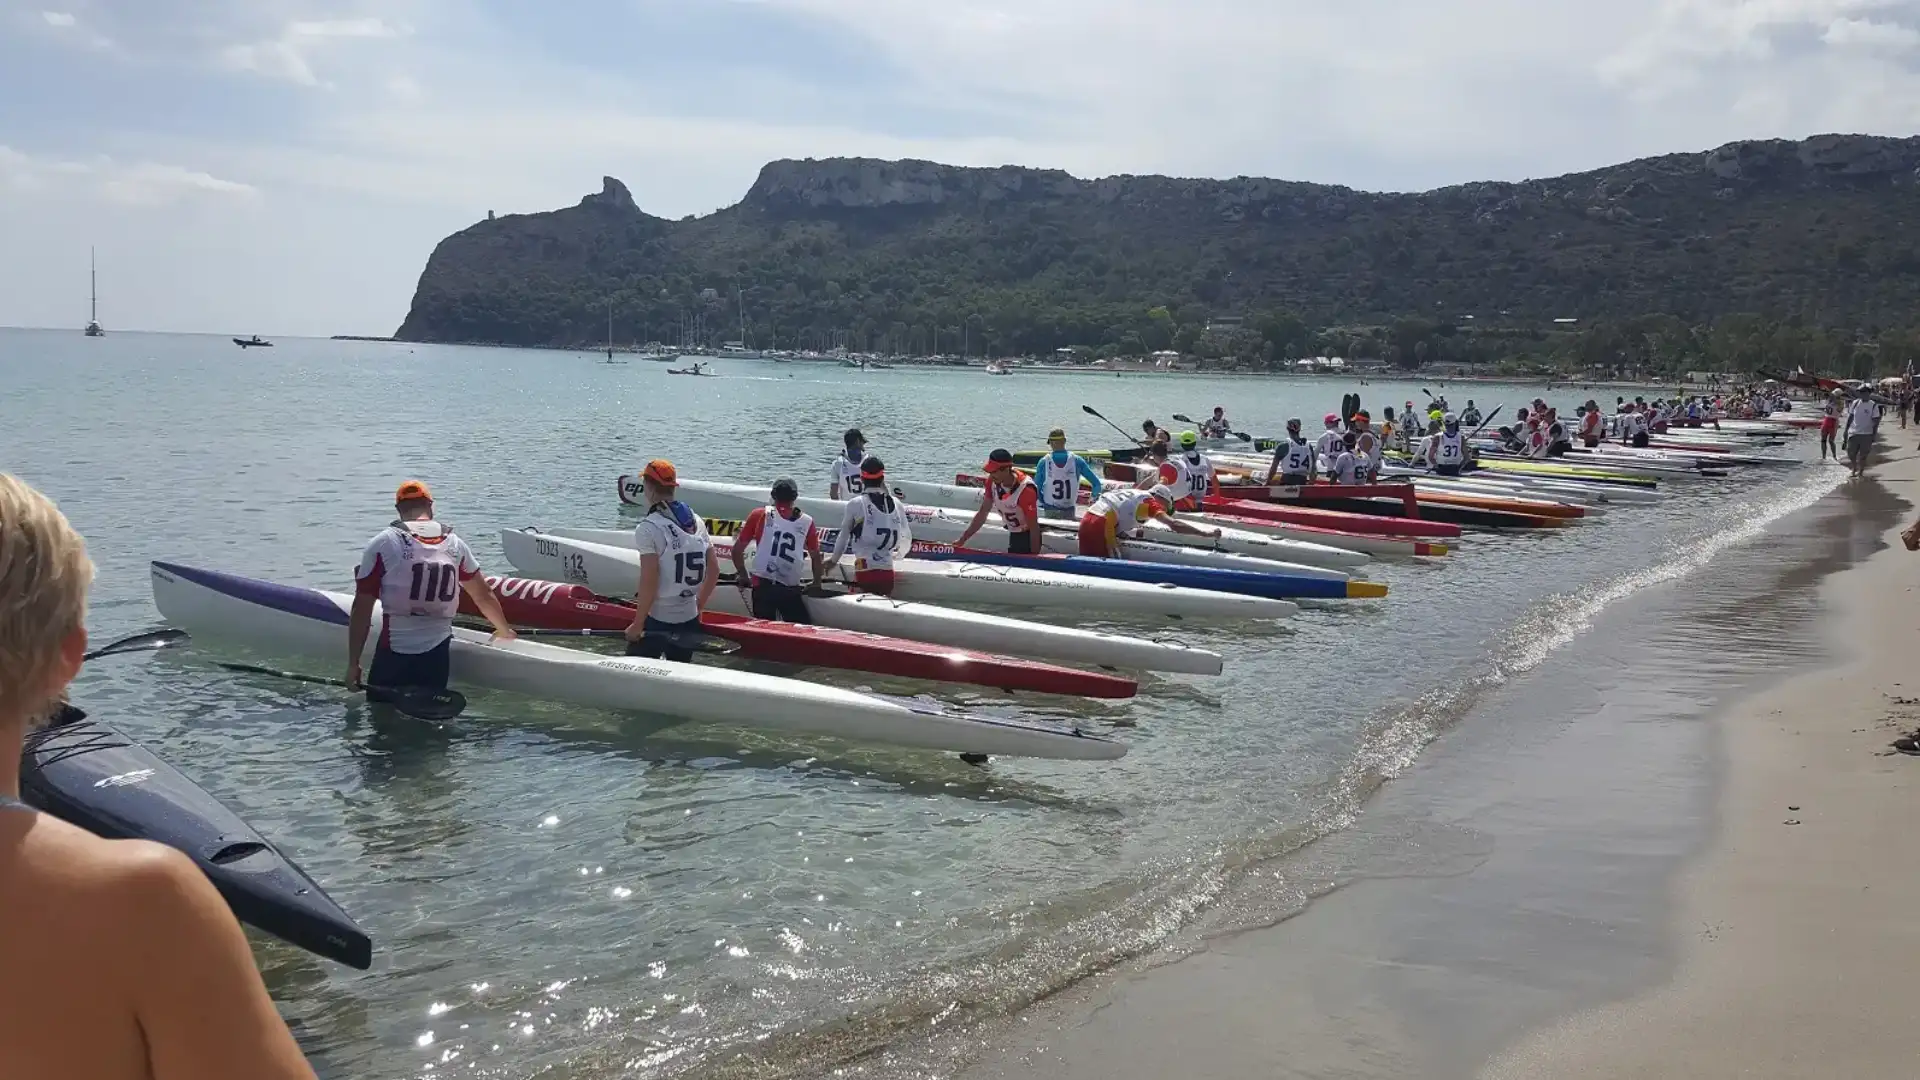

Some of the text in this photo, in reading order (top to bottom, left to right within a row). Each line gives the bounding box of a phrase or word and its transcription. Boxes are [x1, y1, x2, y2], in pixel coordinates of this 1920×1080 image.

[1290, 453, 1309, 469] 54
[1443, 445, 1458, 458] 37
[1052, 479, 1072, 500] 31
[771, 530, 796, 563] 12
[876, 527, 898, 551] 71
[570, 552, 584, 571] 12
[674, 551, 704, 586] 15
[409, 561, 456, 602] 110
